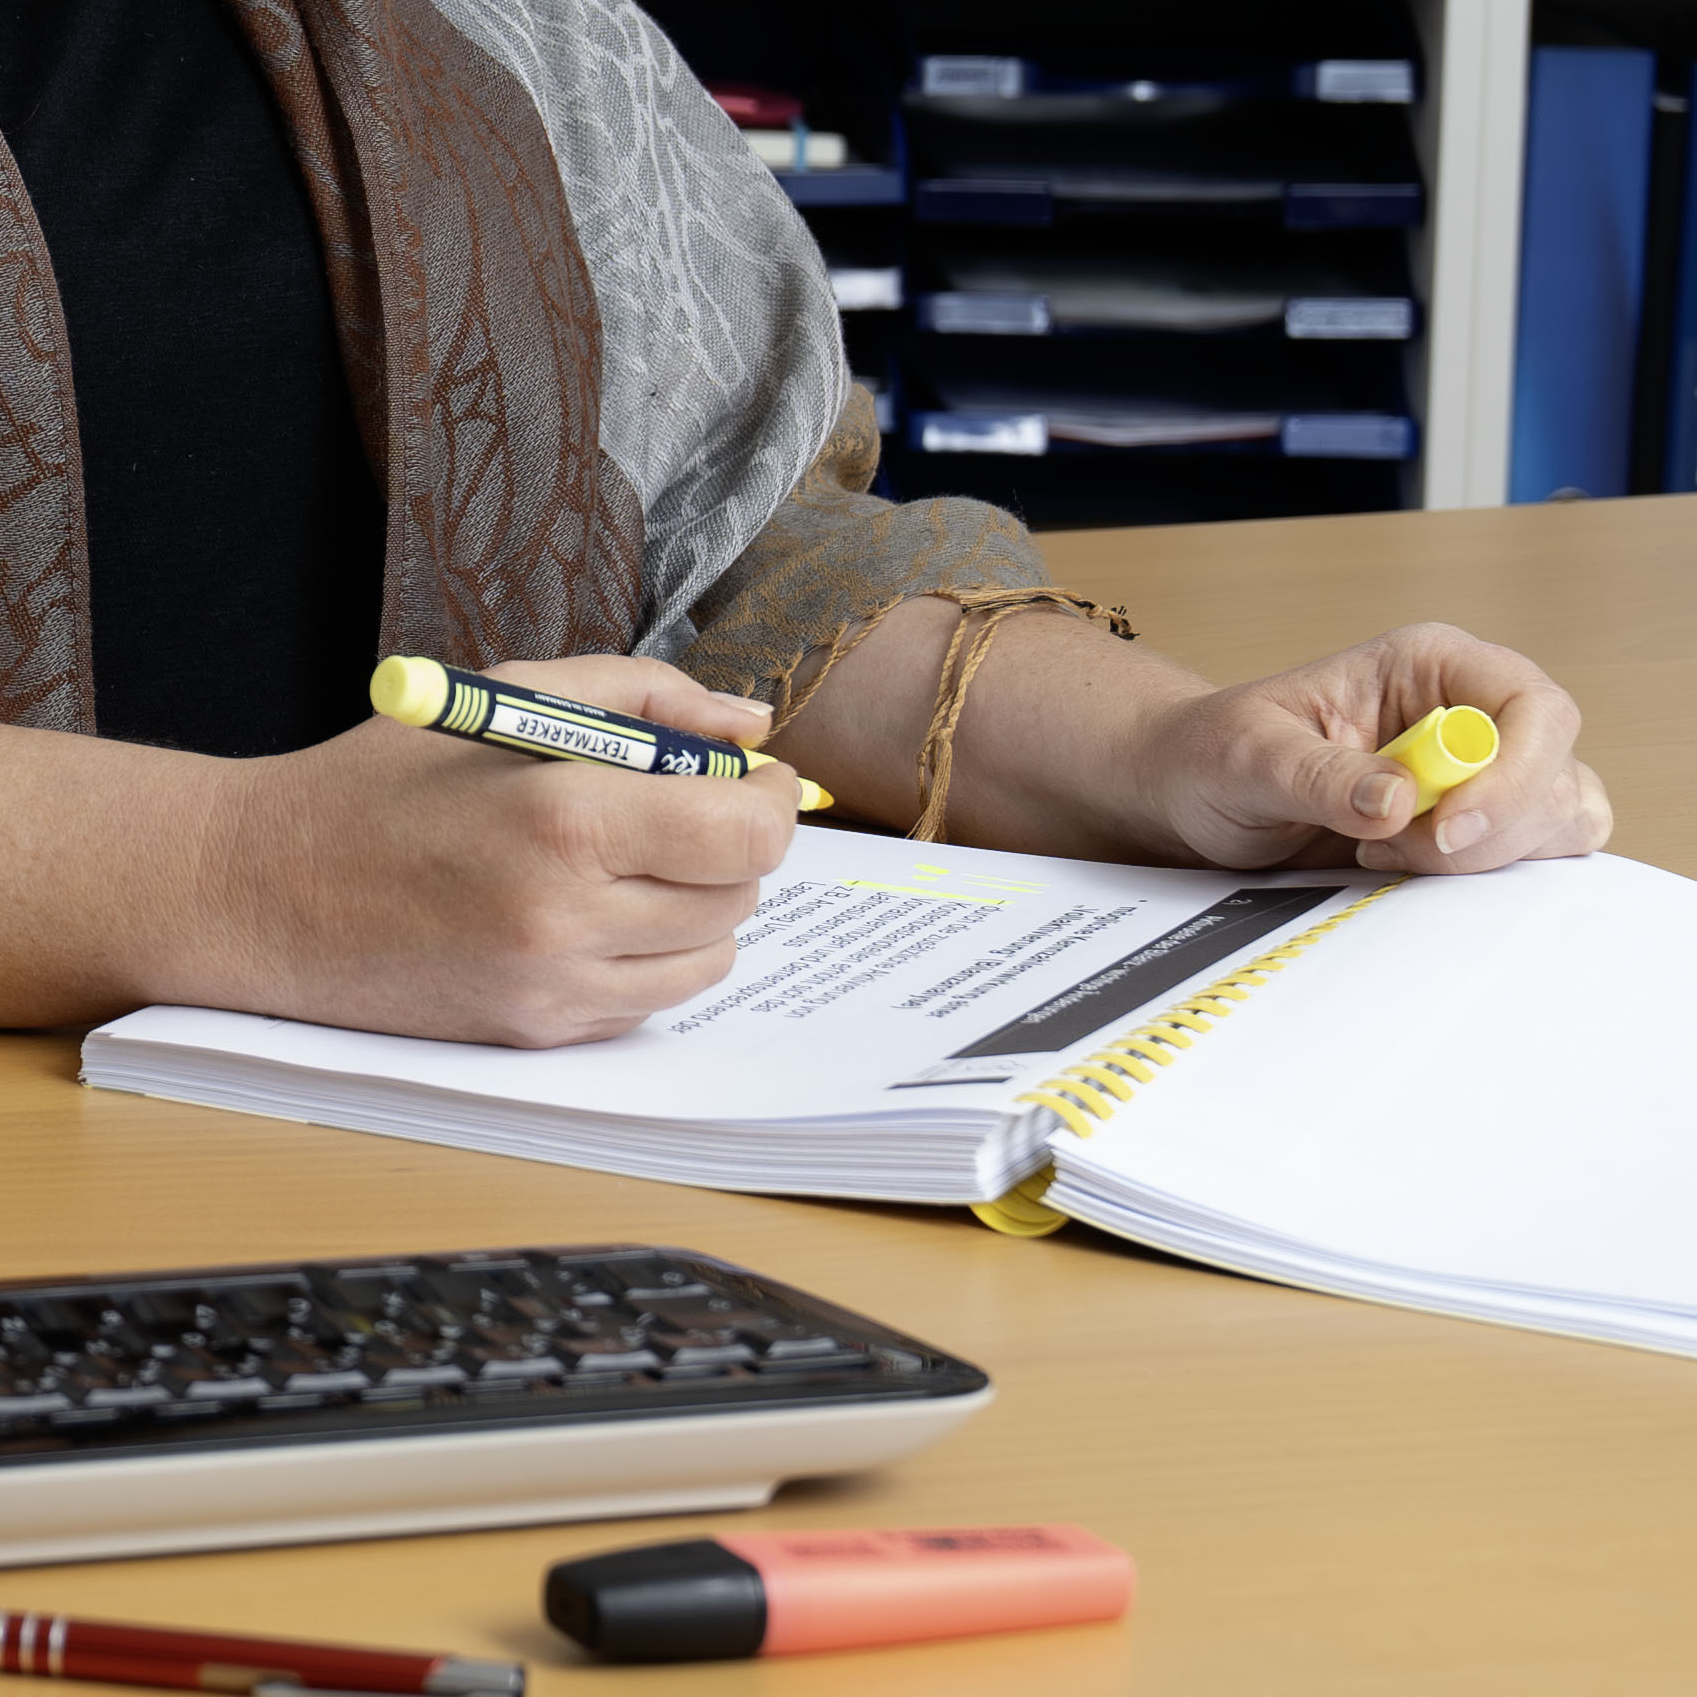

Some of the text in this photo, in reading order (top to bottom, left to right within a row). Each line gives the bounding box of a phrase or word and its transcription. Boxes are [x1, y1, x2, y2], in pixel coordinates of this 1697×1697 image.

[517, 716, 629, 760] TEXTMARKER
[770, 897, 834, 923] Anstieg
[783, 892, 900, 948] Jahresüberschuss
[820, 885, 854, 899] z.B.
[667, 898, 938, 1033] Vorratsvermögen und dementsprechend der
[750, 902, 972, 1012] Kostenbestandteilen erhöht sich das
[783, 905, 1004, 1018] durch die zusätzliche Aktivierung von
[890, 958, 1006, 1009] (Bilanzanalyse)
[926, 906, 1137, 1017] mögliche Kennzahlenwirkung einer
